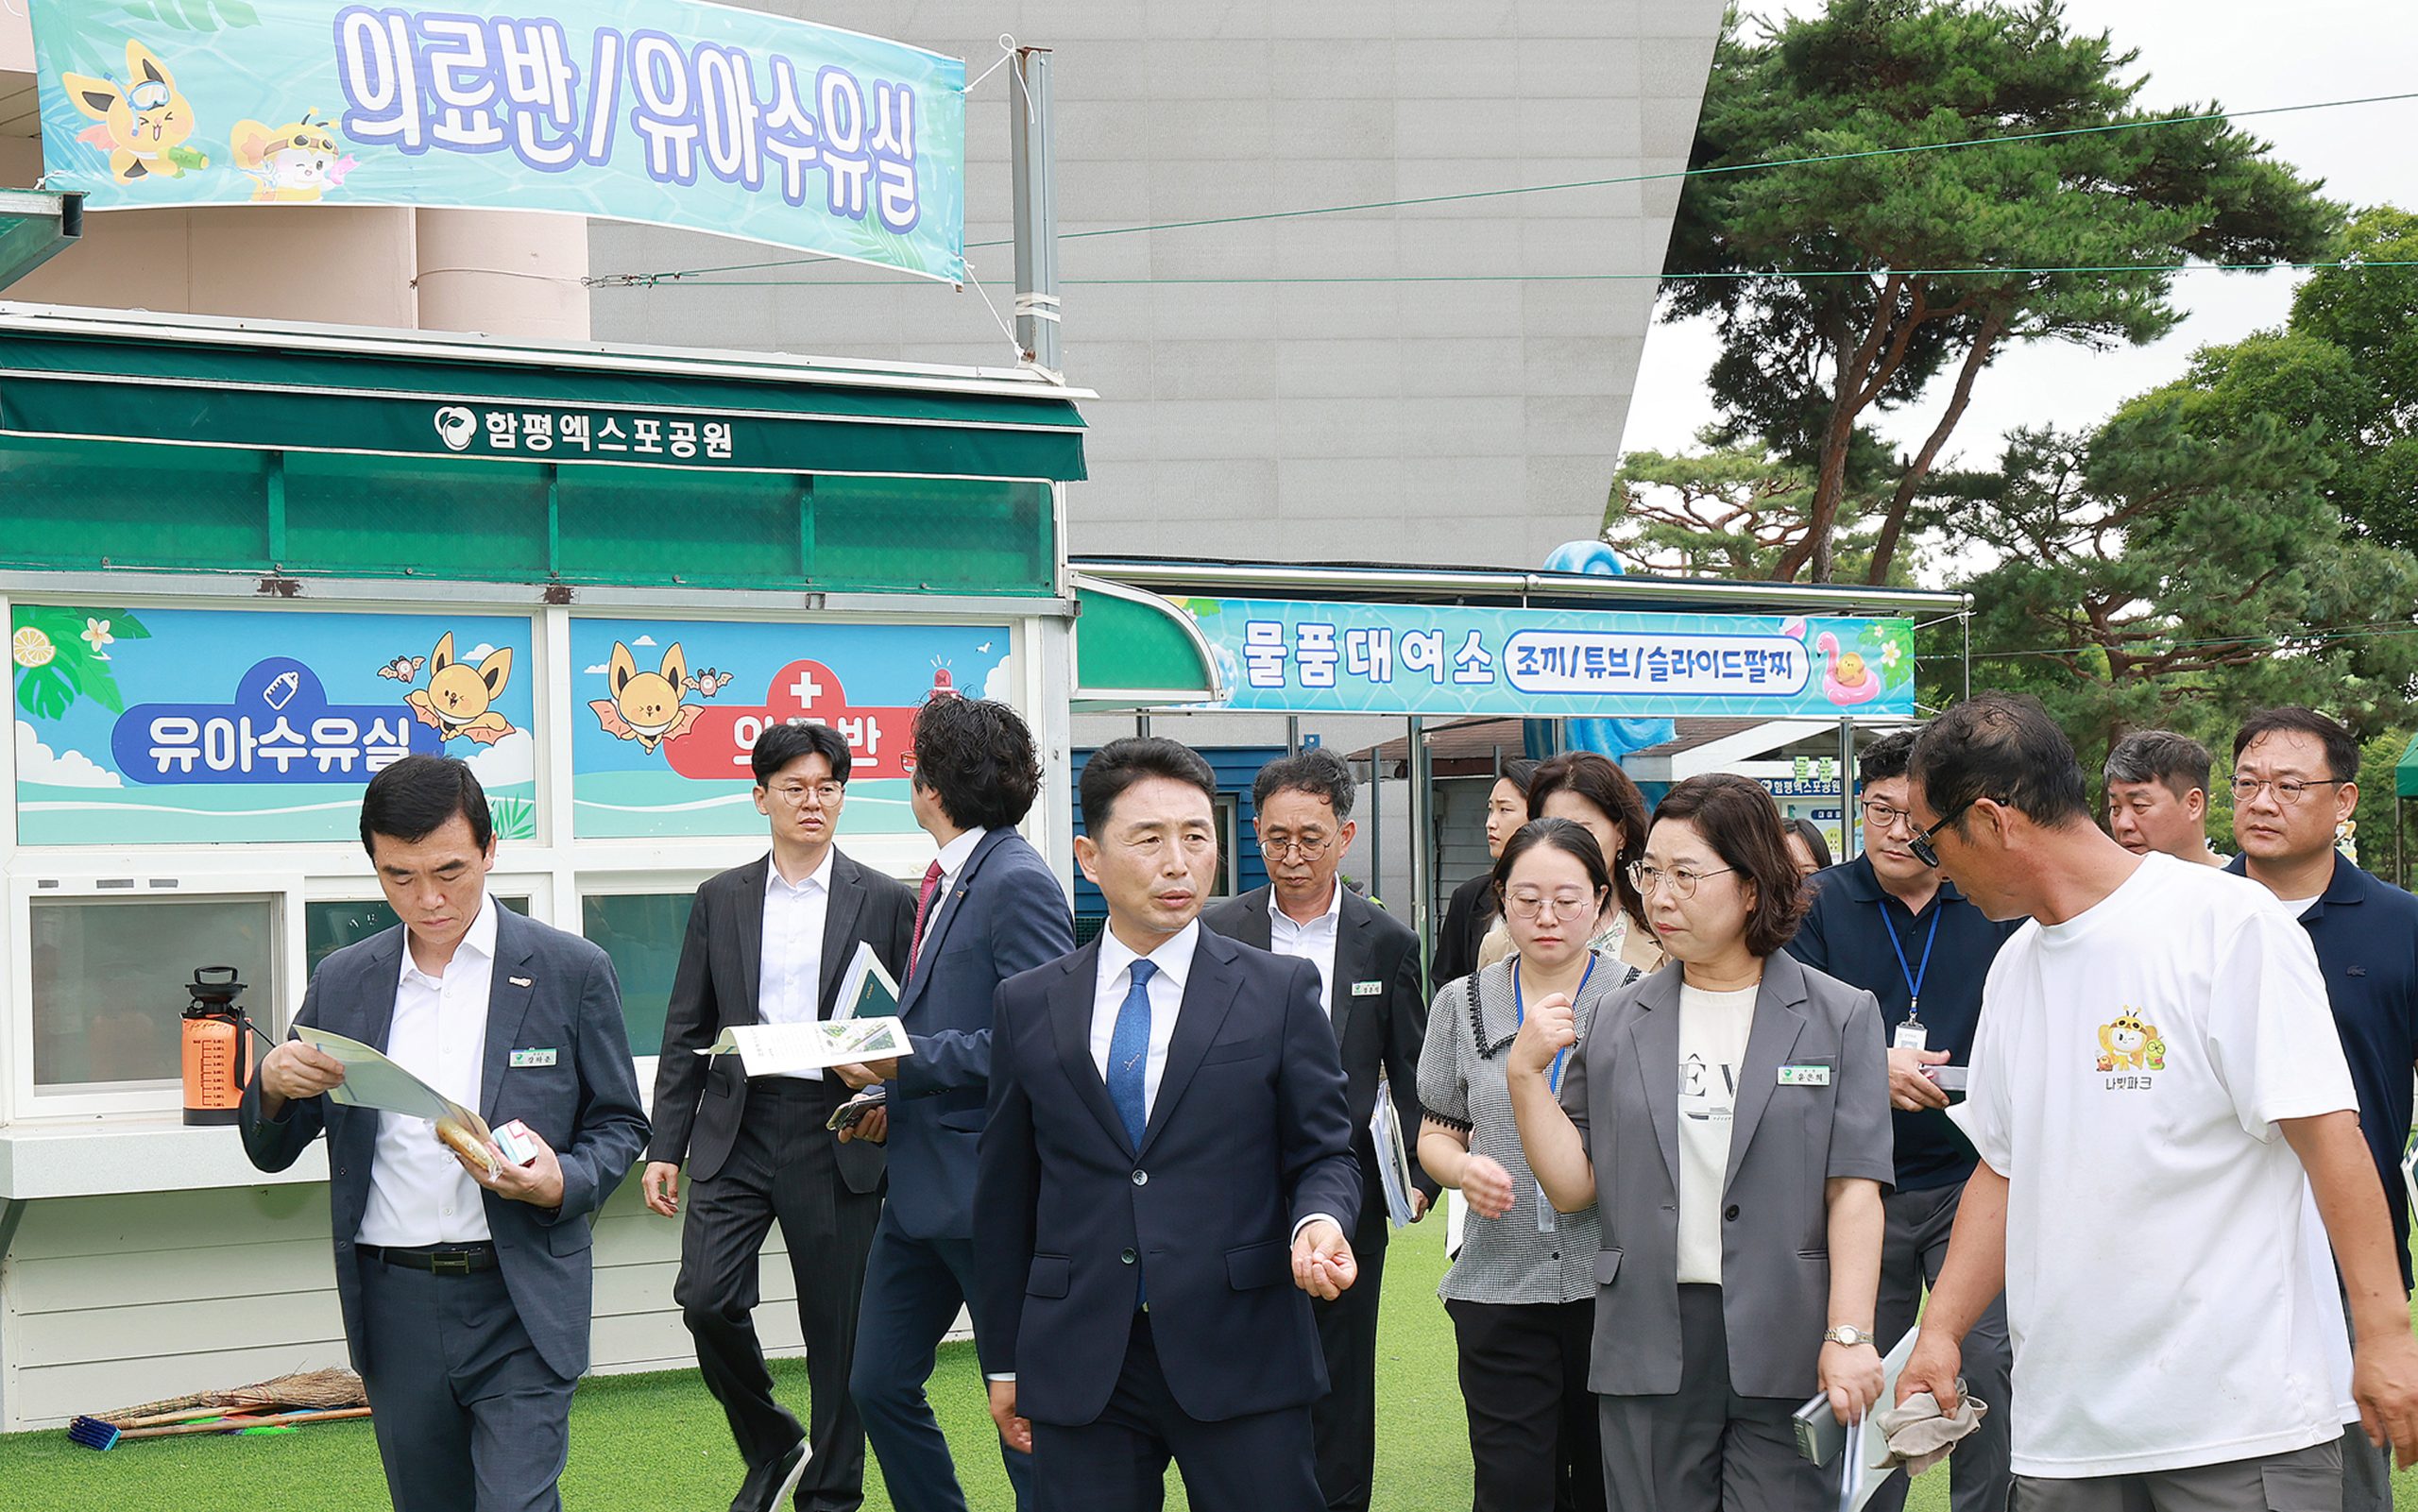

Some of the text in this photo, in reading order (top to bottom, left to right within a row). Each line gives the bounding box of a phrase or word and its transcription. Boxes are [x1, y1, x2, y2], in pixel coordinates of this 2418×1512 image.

[336, 8, 919, 232] 의료반/유아수유실
[485, 411, 733, 459] 함평엑스포공원
[1243, 620, 1792, 688] 물품대여소 조끼/튜브/슬라이드팔찌
[148, 716, 411, 772] 유아수유실
[733, 715, 882, 767] 의반
